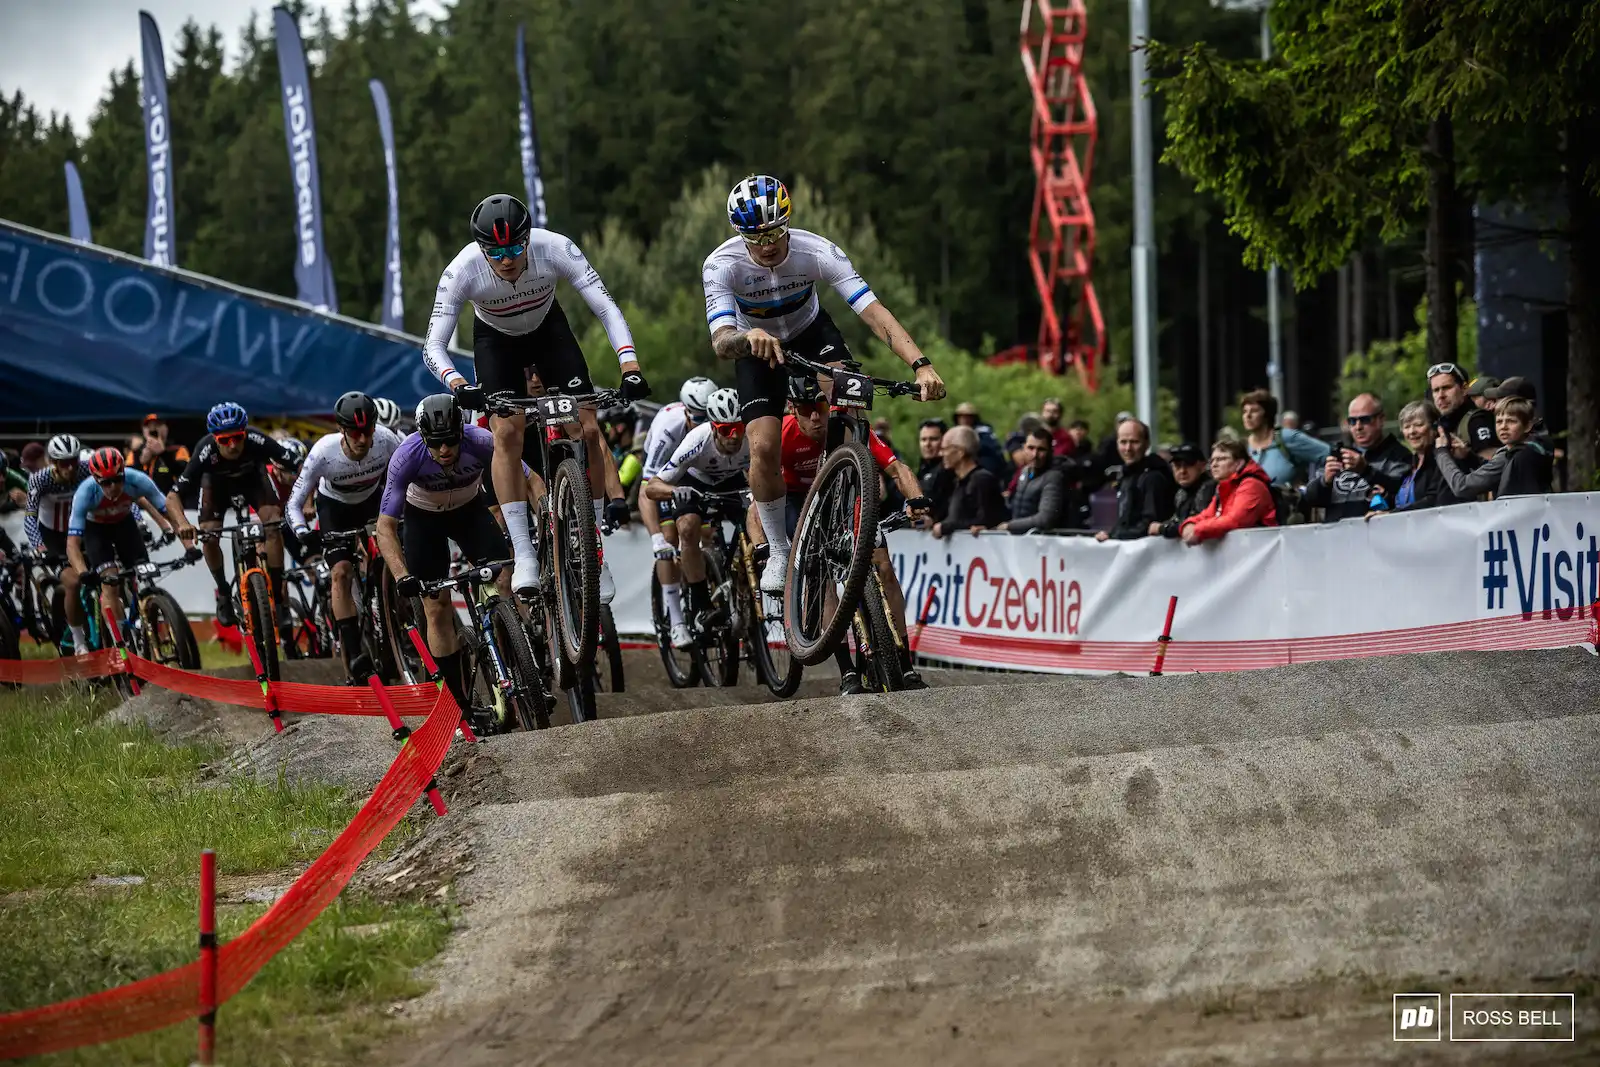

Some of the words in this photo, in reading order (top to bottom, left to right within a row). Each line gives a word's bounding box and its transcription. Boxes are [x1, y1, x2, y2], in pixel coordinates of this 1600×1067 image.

[482, 283, 551, 305] cannondale
[846, 378, 861, 396] 2
[544, 399, 572, 414] 18
[679, 440, 705, 463] GIANT
[241, 525, 260, 538] 14
[480, 567, 493, 581] 9
[1483, 522, 1600, 620] #Visit
[891, 552, 1081, 635] VisitCzechia
